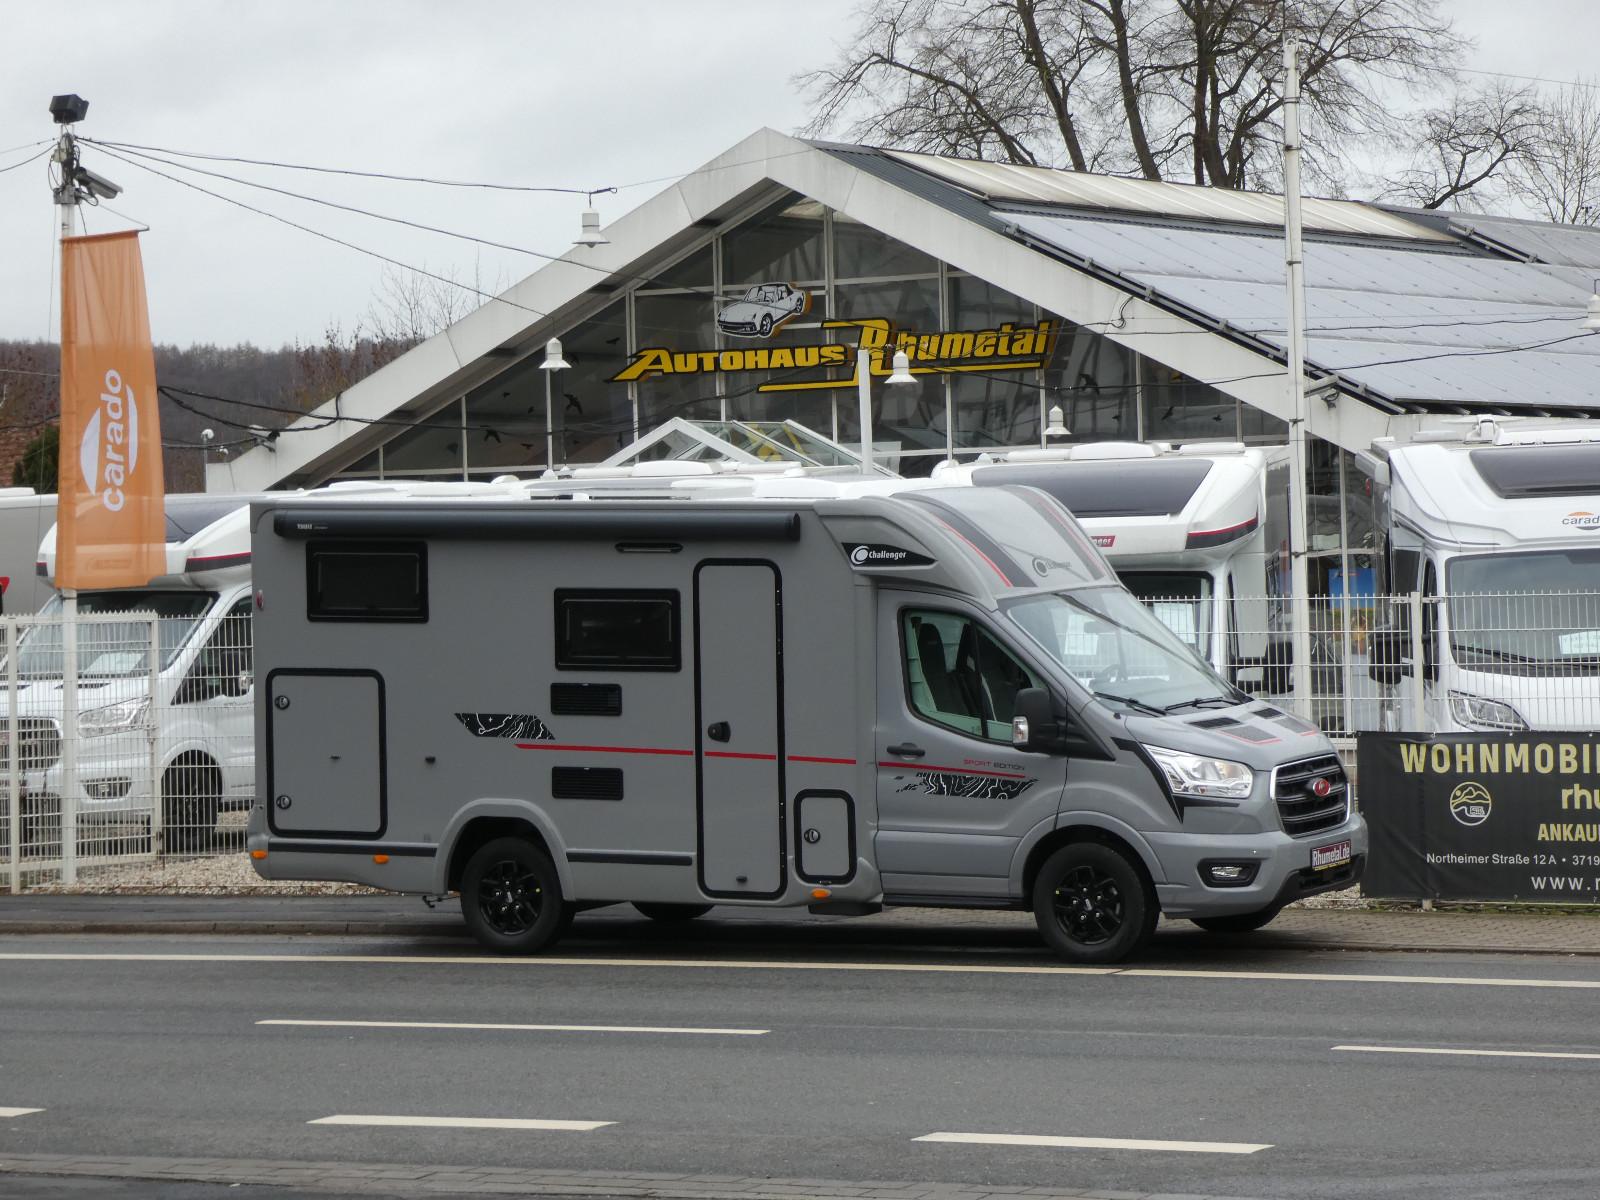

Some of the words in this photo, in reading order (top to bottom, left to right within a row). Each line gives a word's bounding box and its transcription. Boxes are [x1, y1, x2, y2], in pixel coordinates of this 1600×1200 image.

[607, 344, 848, 382] AUTOHAUS
[100, 368, 125, 512] carado
[868, 550, 907, 561] Challenger
[963, 759, 992, 767] SPORT
[993, 761, 1025, 771] EDITION
[1537, 823, 1600, 842] ANKAU
[1426, 853, 1489, 865] Northeimer
[1492, 854, 1530, 865] Straße
